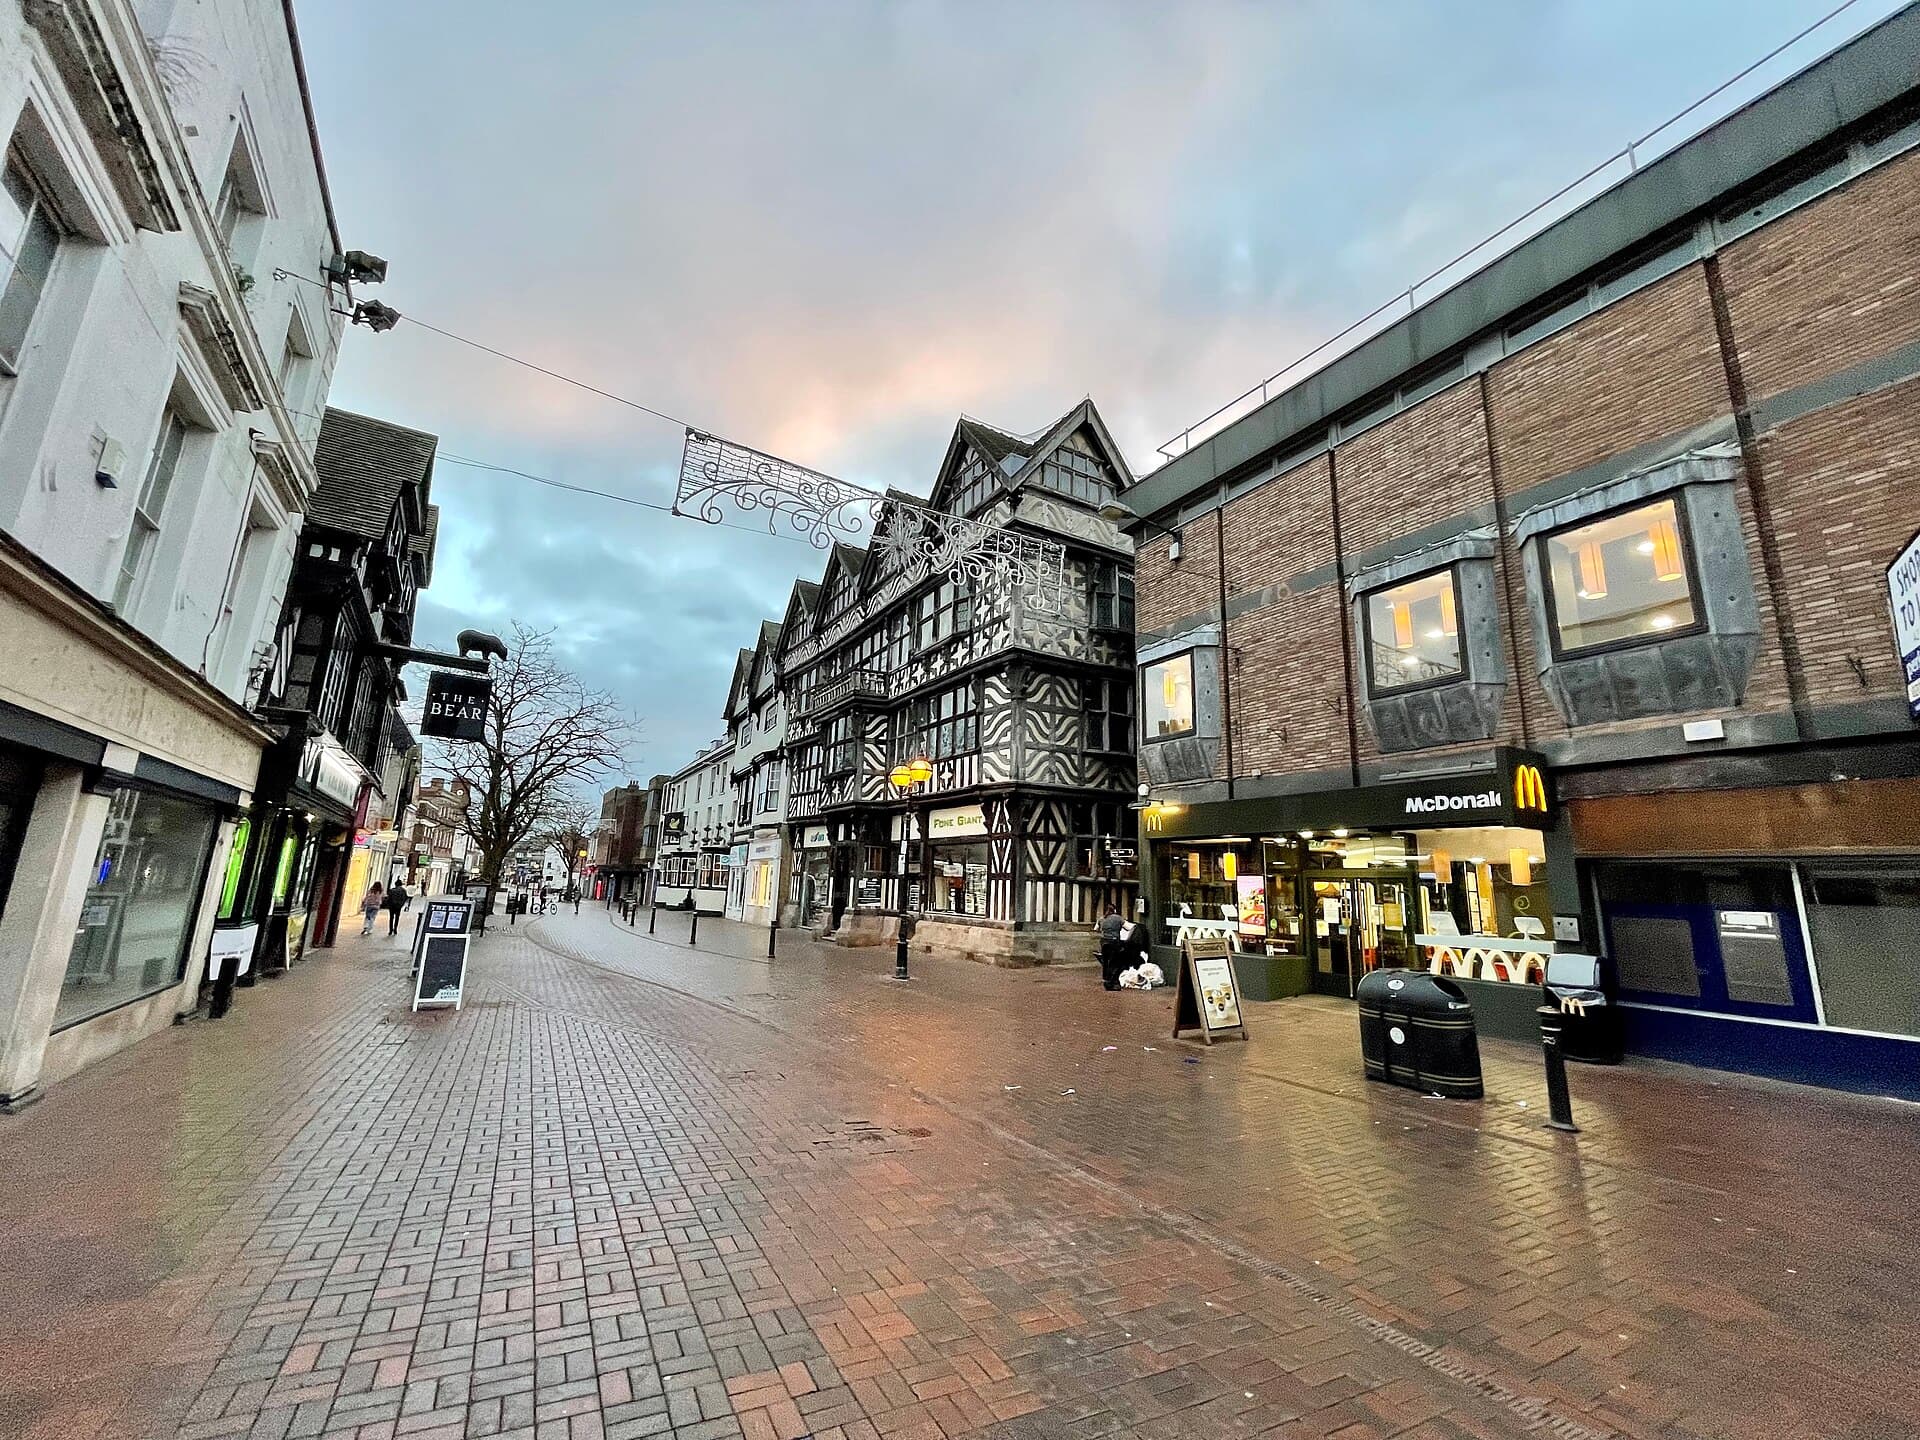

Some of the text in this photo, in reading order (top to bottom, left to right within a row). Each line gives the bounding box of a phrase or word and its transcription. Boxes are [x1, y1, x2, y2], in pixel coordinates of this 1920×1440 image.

[1900, 600, 1915, 631] TO
[440, 692, 476, 705] THE
[430, 702, 482, 720] BEAR
[933, 815, 983, 829] FONE GIANT
